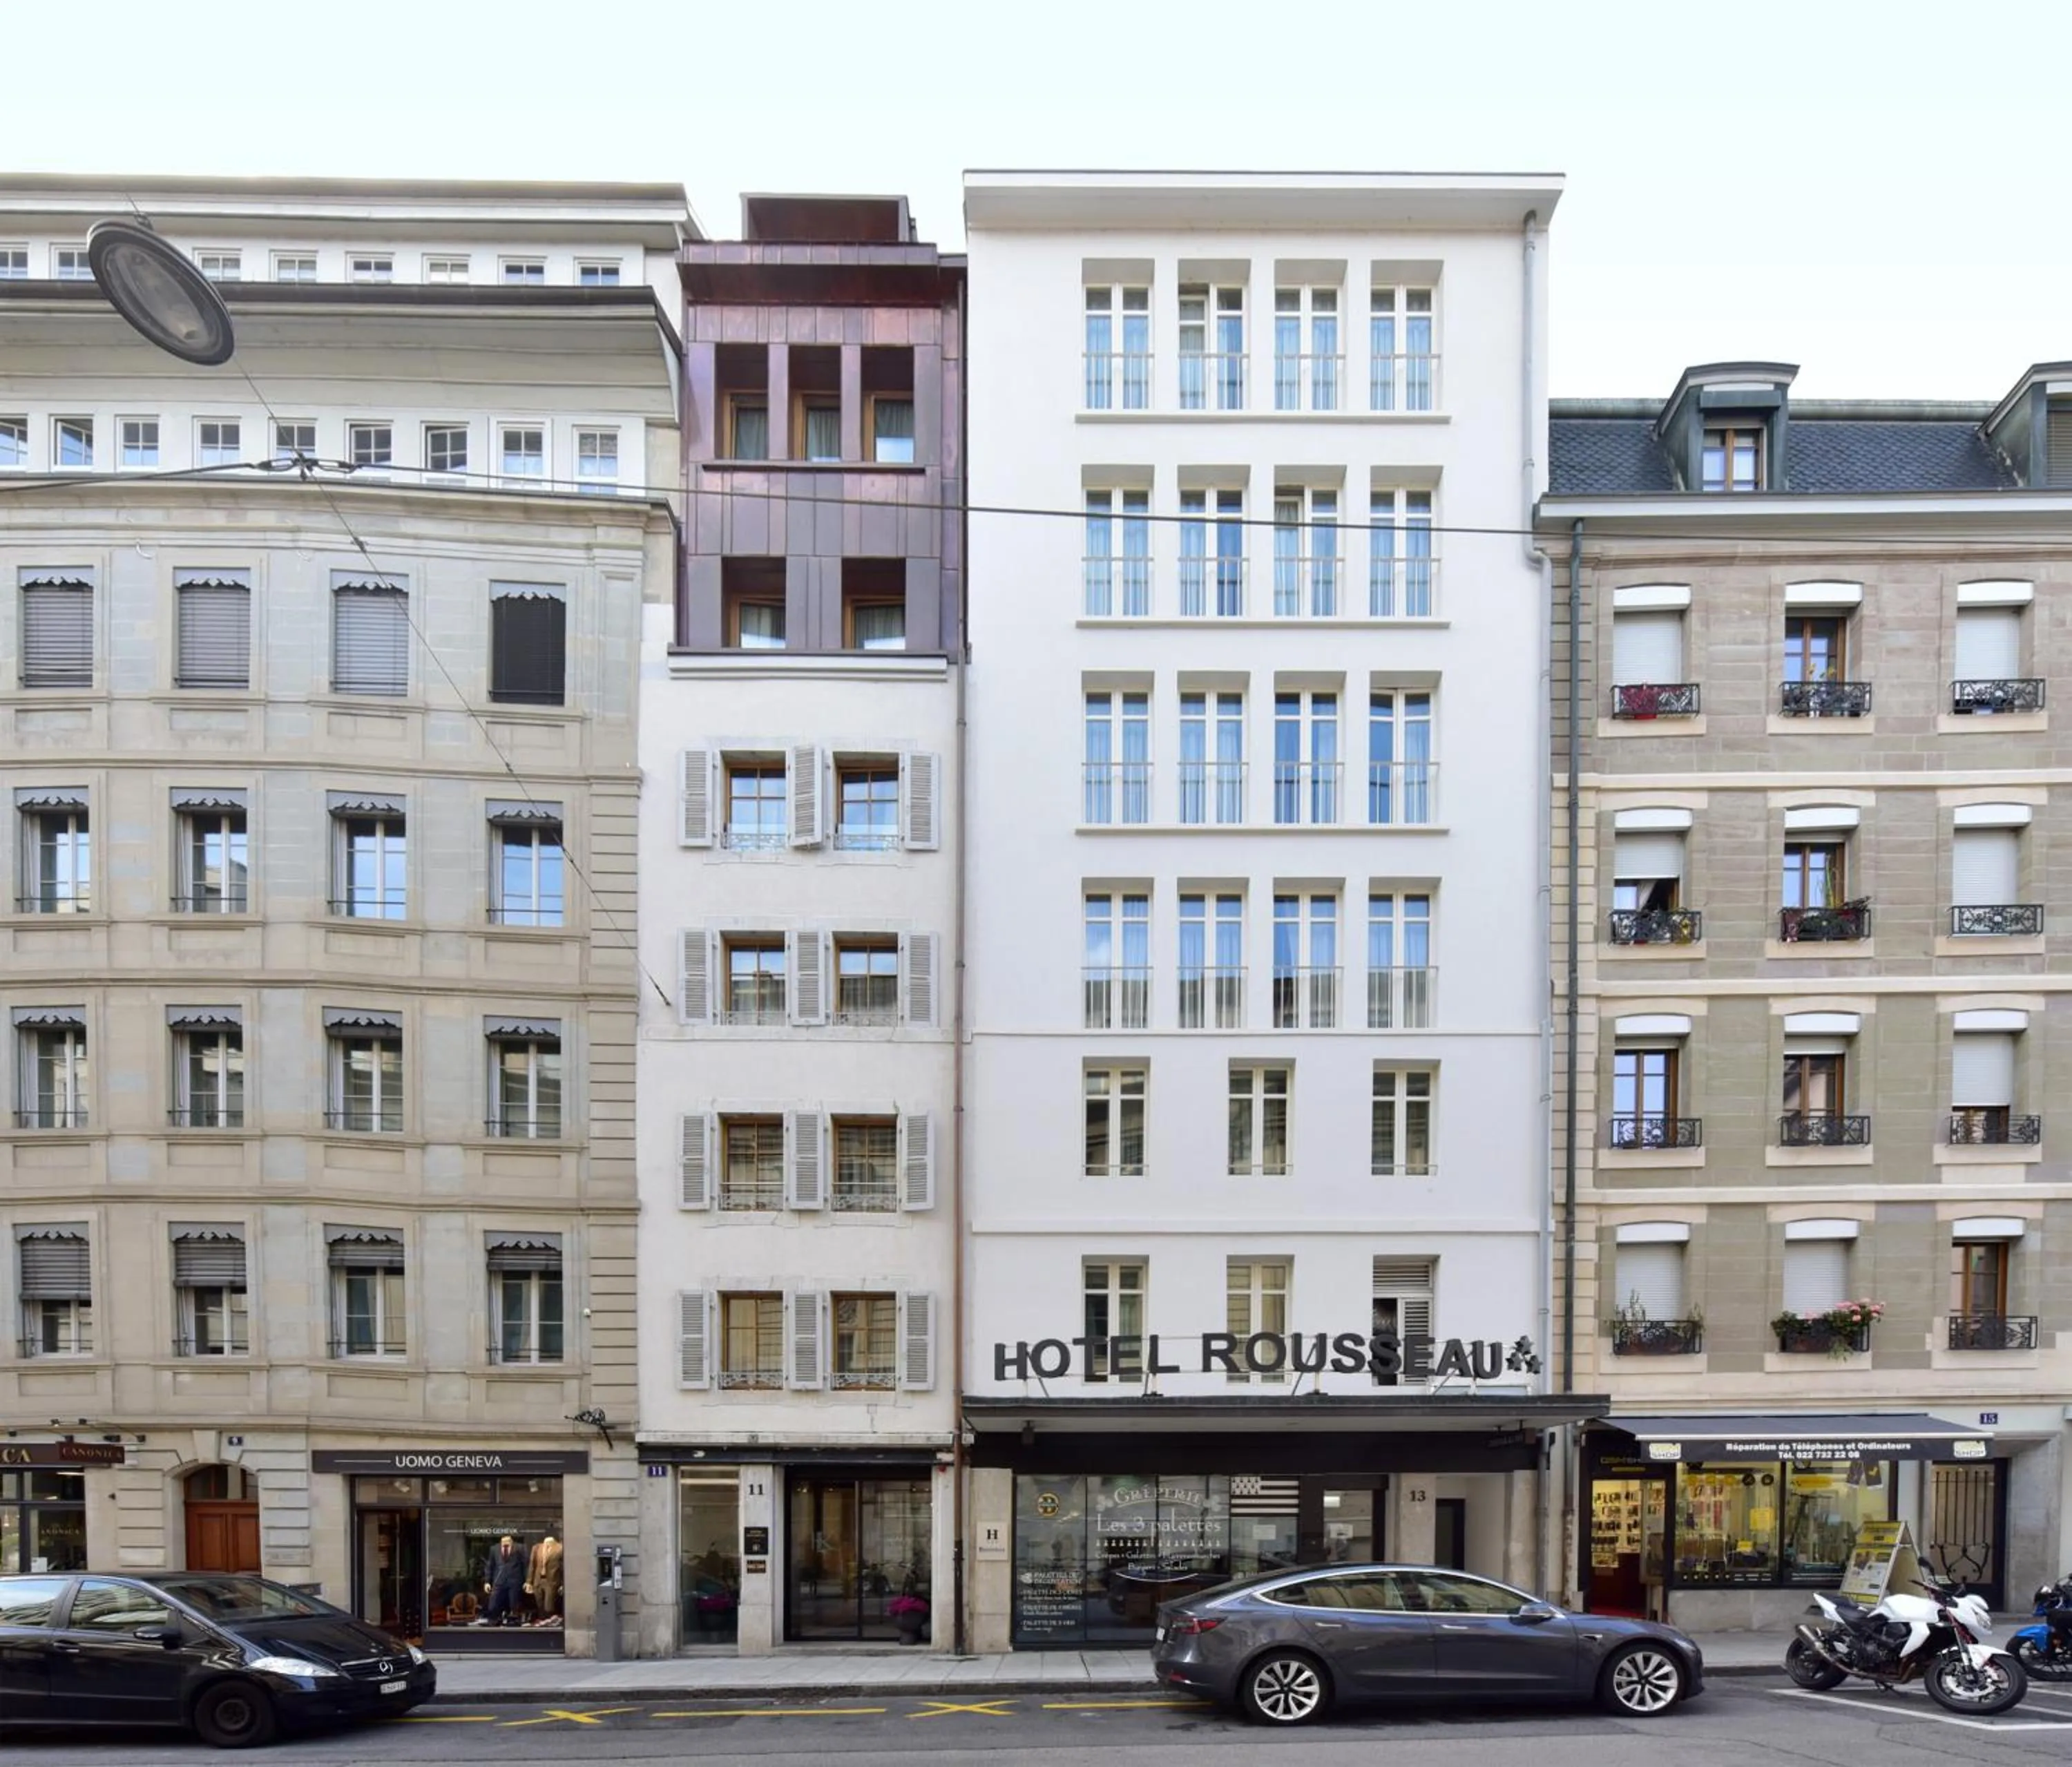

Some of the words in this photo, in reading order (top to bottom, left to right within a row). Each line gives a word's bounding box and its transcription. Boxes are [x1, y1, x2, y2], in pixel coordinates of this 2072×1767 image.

[995, 1334, 1180, 1380] HOTEL
[1202, 1332, 1503, 1379] ROUSSEAU
[1983, 1414, 1995, 1423] 15
[1726, 1442, 1776, 1452] Réparation
[1792, 1442, 1843, 1452] Téléphones
[1845, 1442, 1855, 1450] et
[1857, 1442, 1911, 1450] Ordinateurs
[395, 1455, 443, 1468] UOMO
[445, 1455, 502, 1468] GENEVA
[651, 1466, 662, 1475] 11
[749, 1484, 763, 1495] 11
[1410, 1489, 1426, 1502] 13
[1097, 1513, 1127, 1532] Les
[1133, 1516, 1145, 1532] 3
[1149, 1508, 1222, 1547] palettes
[987, 1529, 998, 1540] H
